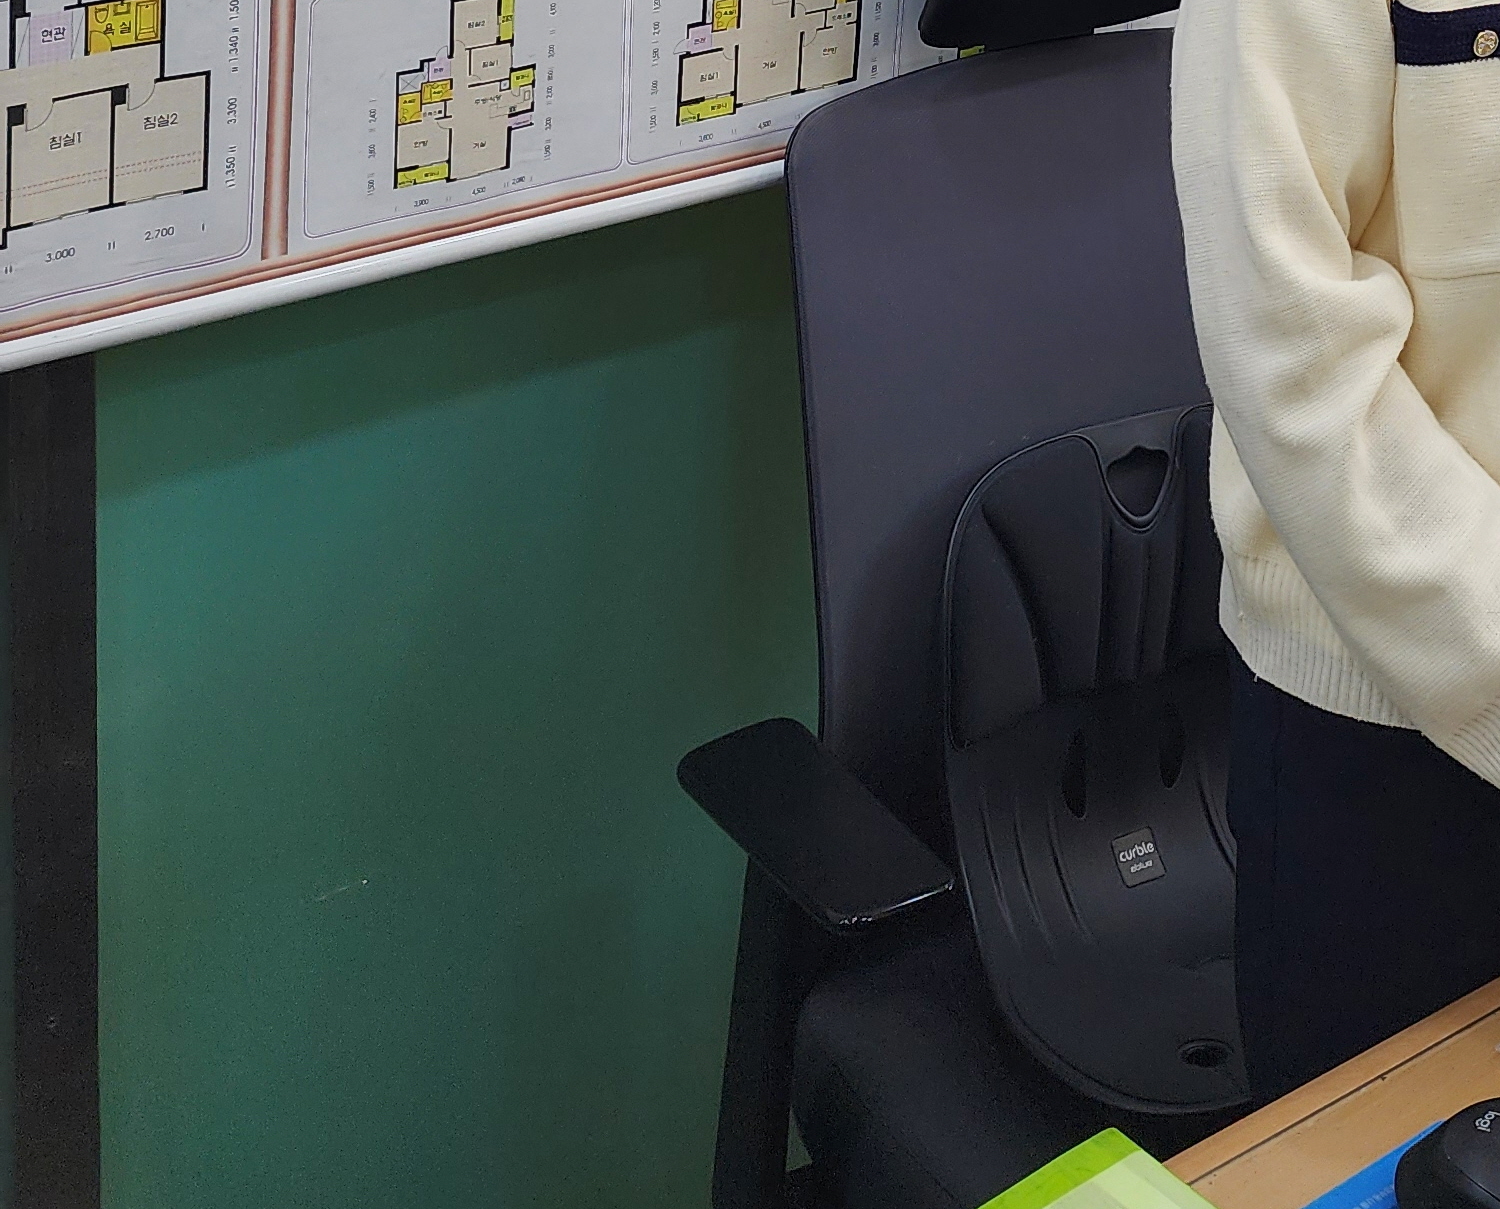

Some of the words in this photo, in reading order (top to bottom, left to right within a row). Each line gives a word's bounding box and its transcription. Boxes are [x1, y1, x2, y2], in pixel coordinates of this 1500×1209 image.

[143, 112, 179, 131] 침실2
[49, 131, 82, 151] 침실1
[1119, 842, 1154, 862] curble
